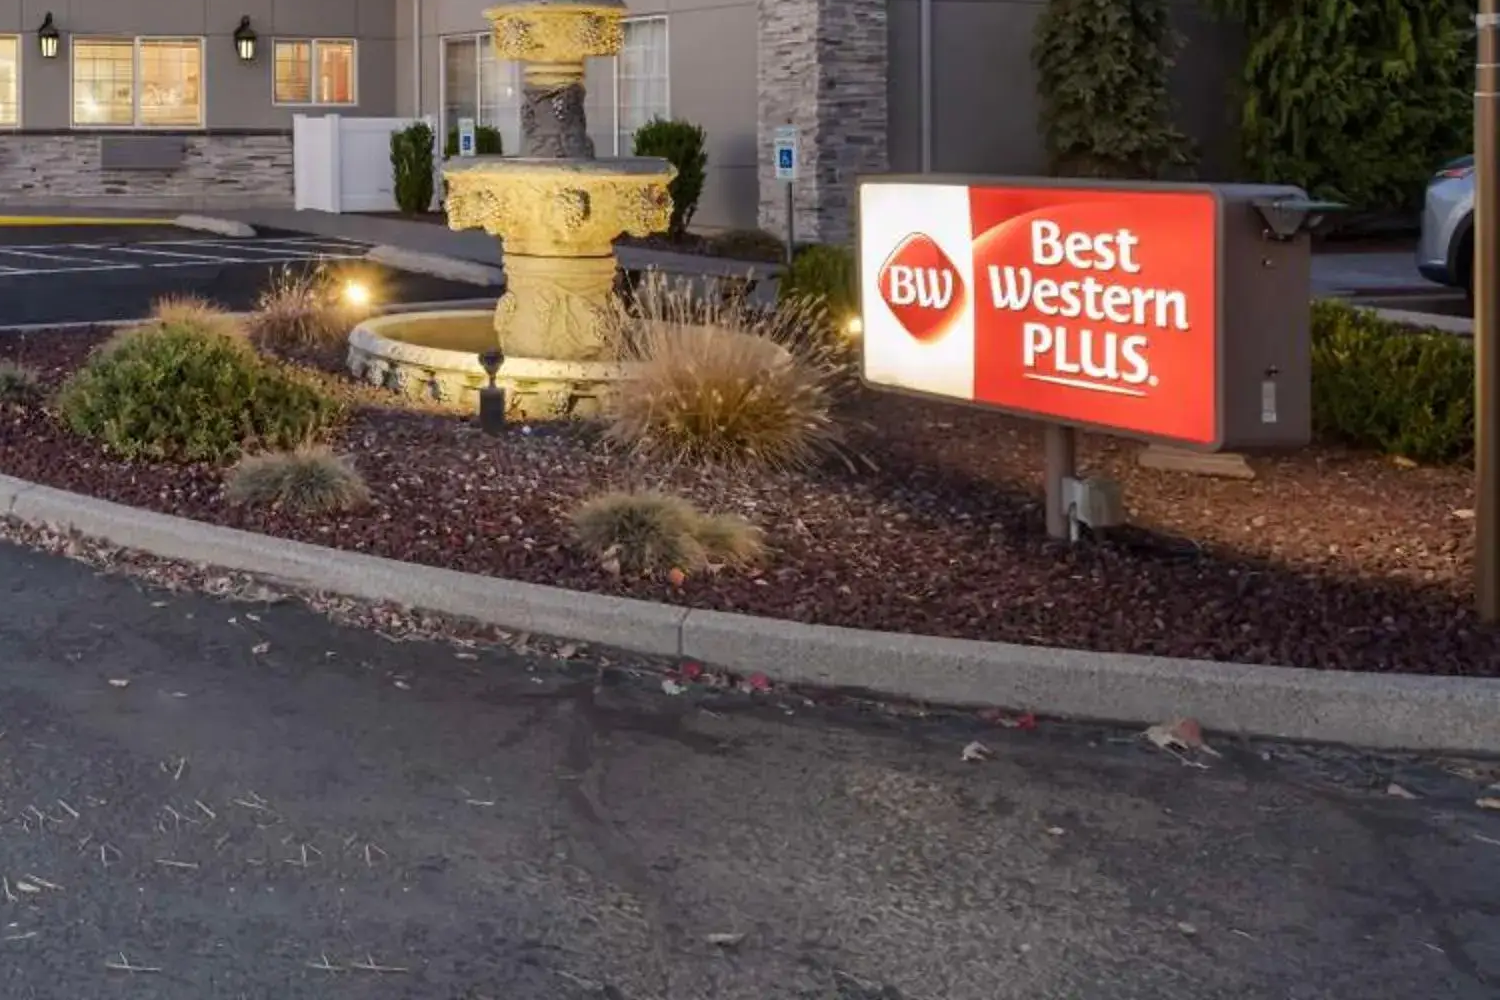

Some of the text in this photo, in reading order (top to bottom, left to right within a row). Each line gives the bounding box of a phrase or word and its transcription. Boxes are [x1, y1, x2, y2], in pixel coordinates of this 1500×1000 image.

[1031, 219, 1141, 274] Best
[889, 265, 953, 309] BW
[987, 264, 1190, 331] Western
